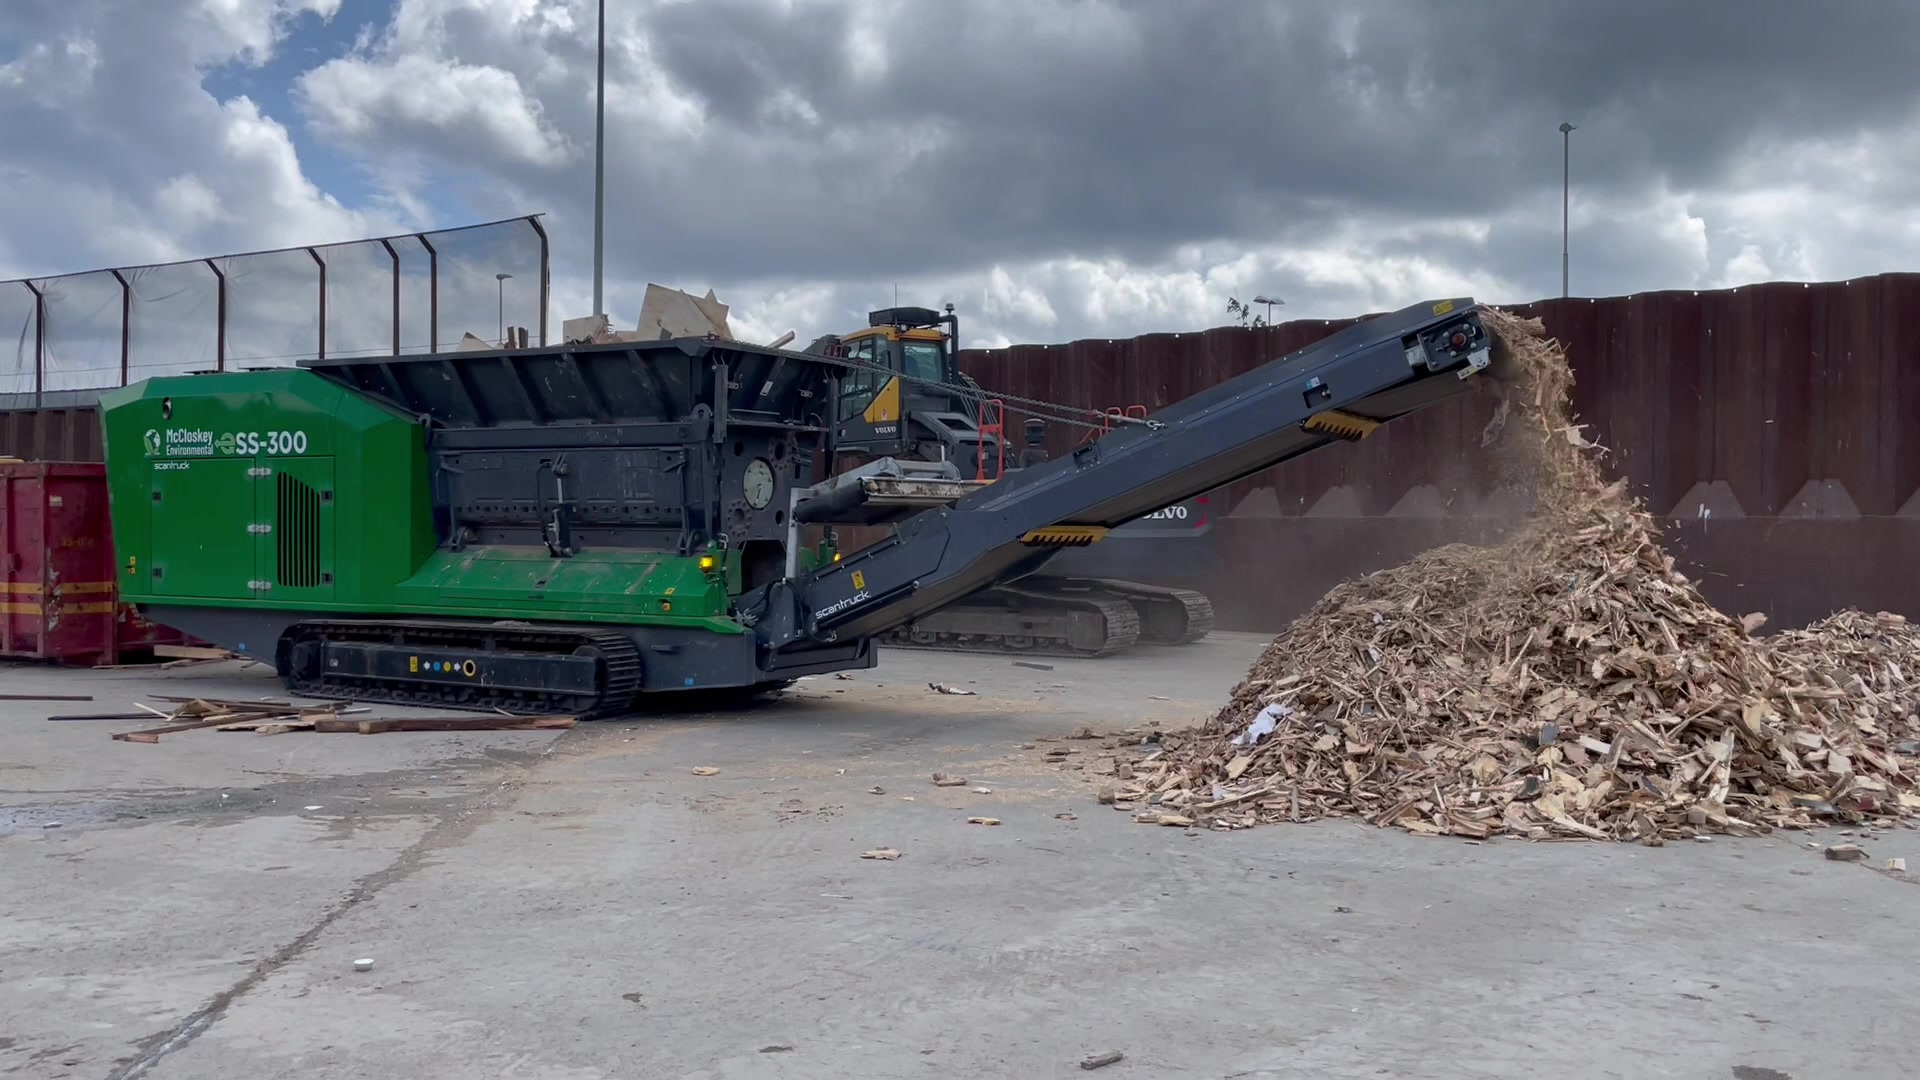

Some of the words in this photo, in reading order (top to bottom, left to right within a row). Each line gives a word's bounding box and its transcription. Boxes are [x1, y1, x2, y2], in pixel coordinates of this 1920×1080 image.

[874, 426, 897, 434] VOLVO
[166, 428, 213, 446] McCloskey
[166, 444, 214, 456] Environmental
[154, 461, 190, 470] scantruck
[815, 590, 871, 620] scantruck
